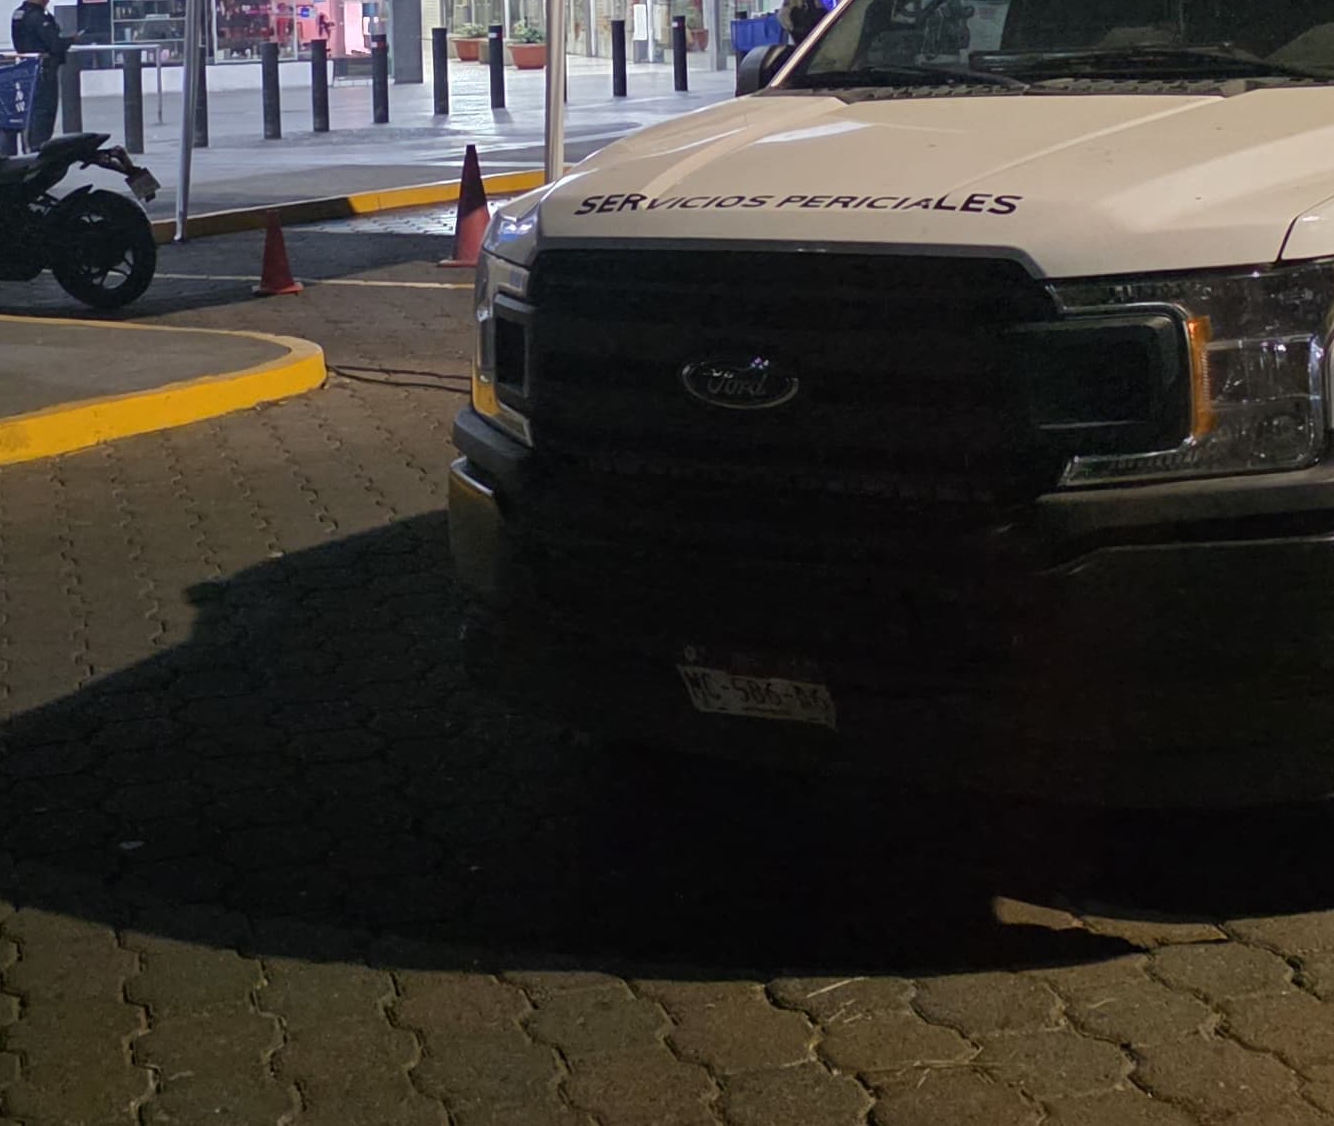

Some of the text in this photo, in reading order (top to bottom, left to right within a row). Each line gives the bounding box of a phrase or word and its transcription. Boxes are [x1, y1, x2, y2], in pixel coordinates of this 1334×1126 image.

[574, 193, 1023, 215] SERVICIOS PERICIALES
[704, 368, 768, 395] Ford
